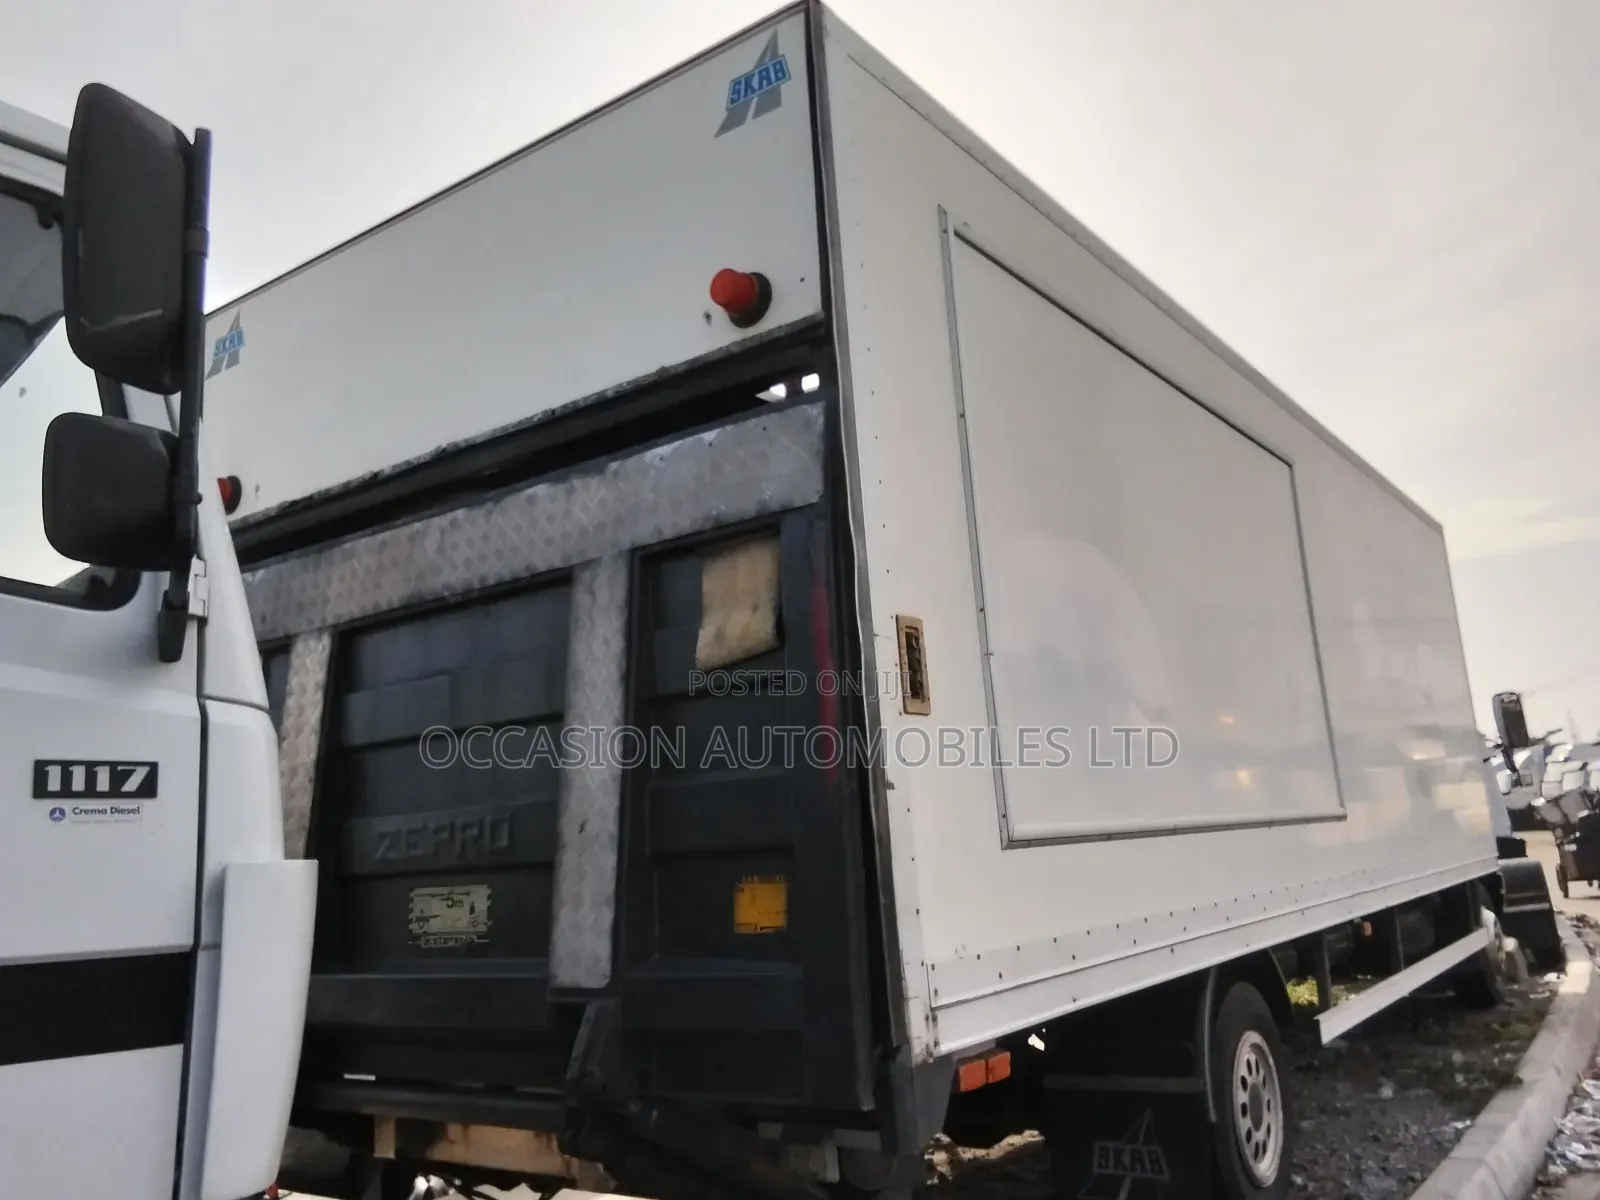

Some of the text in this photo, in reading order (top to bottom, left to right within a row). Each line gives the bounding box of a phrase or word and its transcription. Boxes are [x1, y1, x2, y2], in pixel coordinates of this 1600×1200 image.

[729, 58, 788, 107] SKAB
[212, 329, 244, 357] SKAB
[43, 764, 151, 792] 1117
[71, 805, 141, 816] Crema Diesel
[375, 814, 511, 860] ZEPRO
[1096, 1143, 1167, 1177] SKAB
